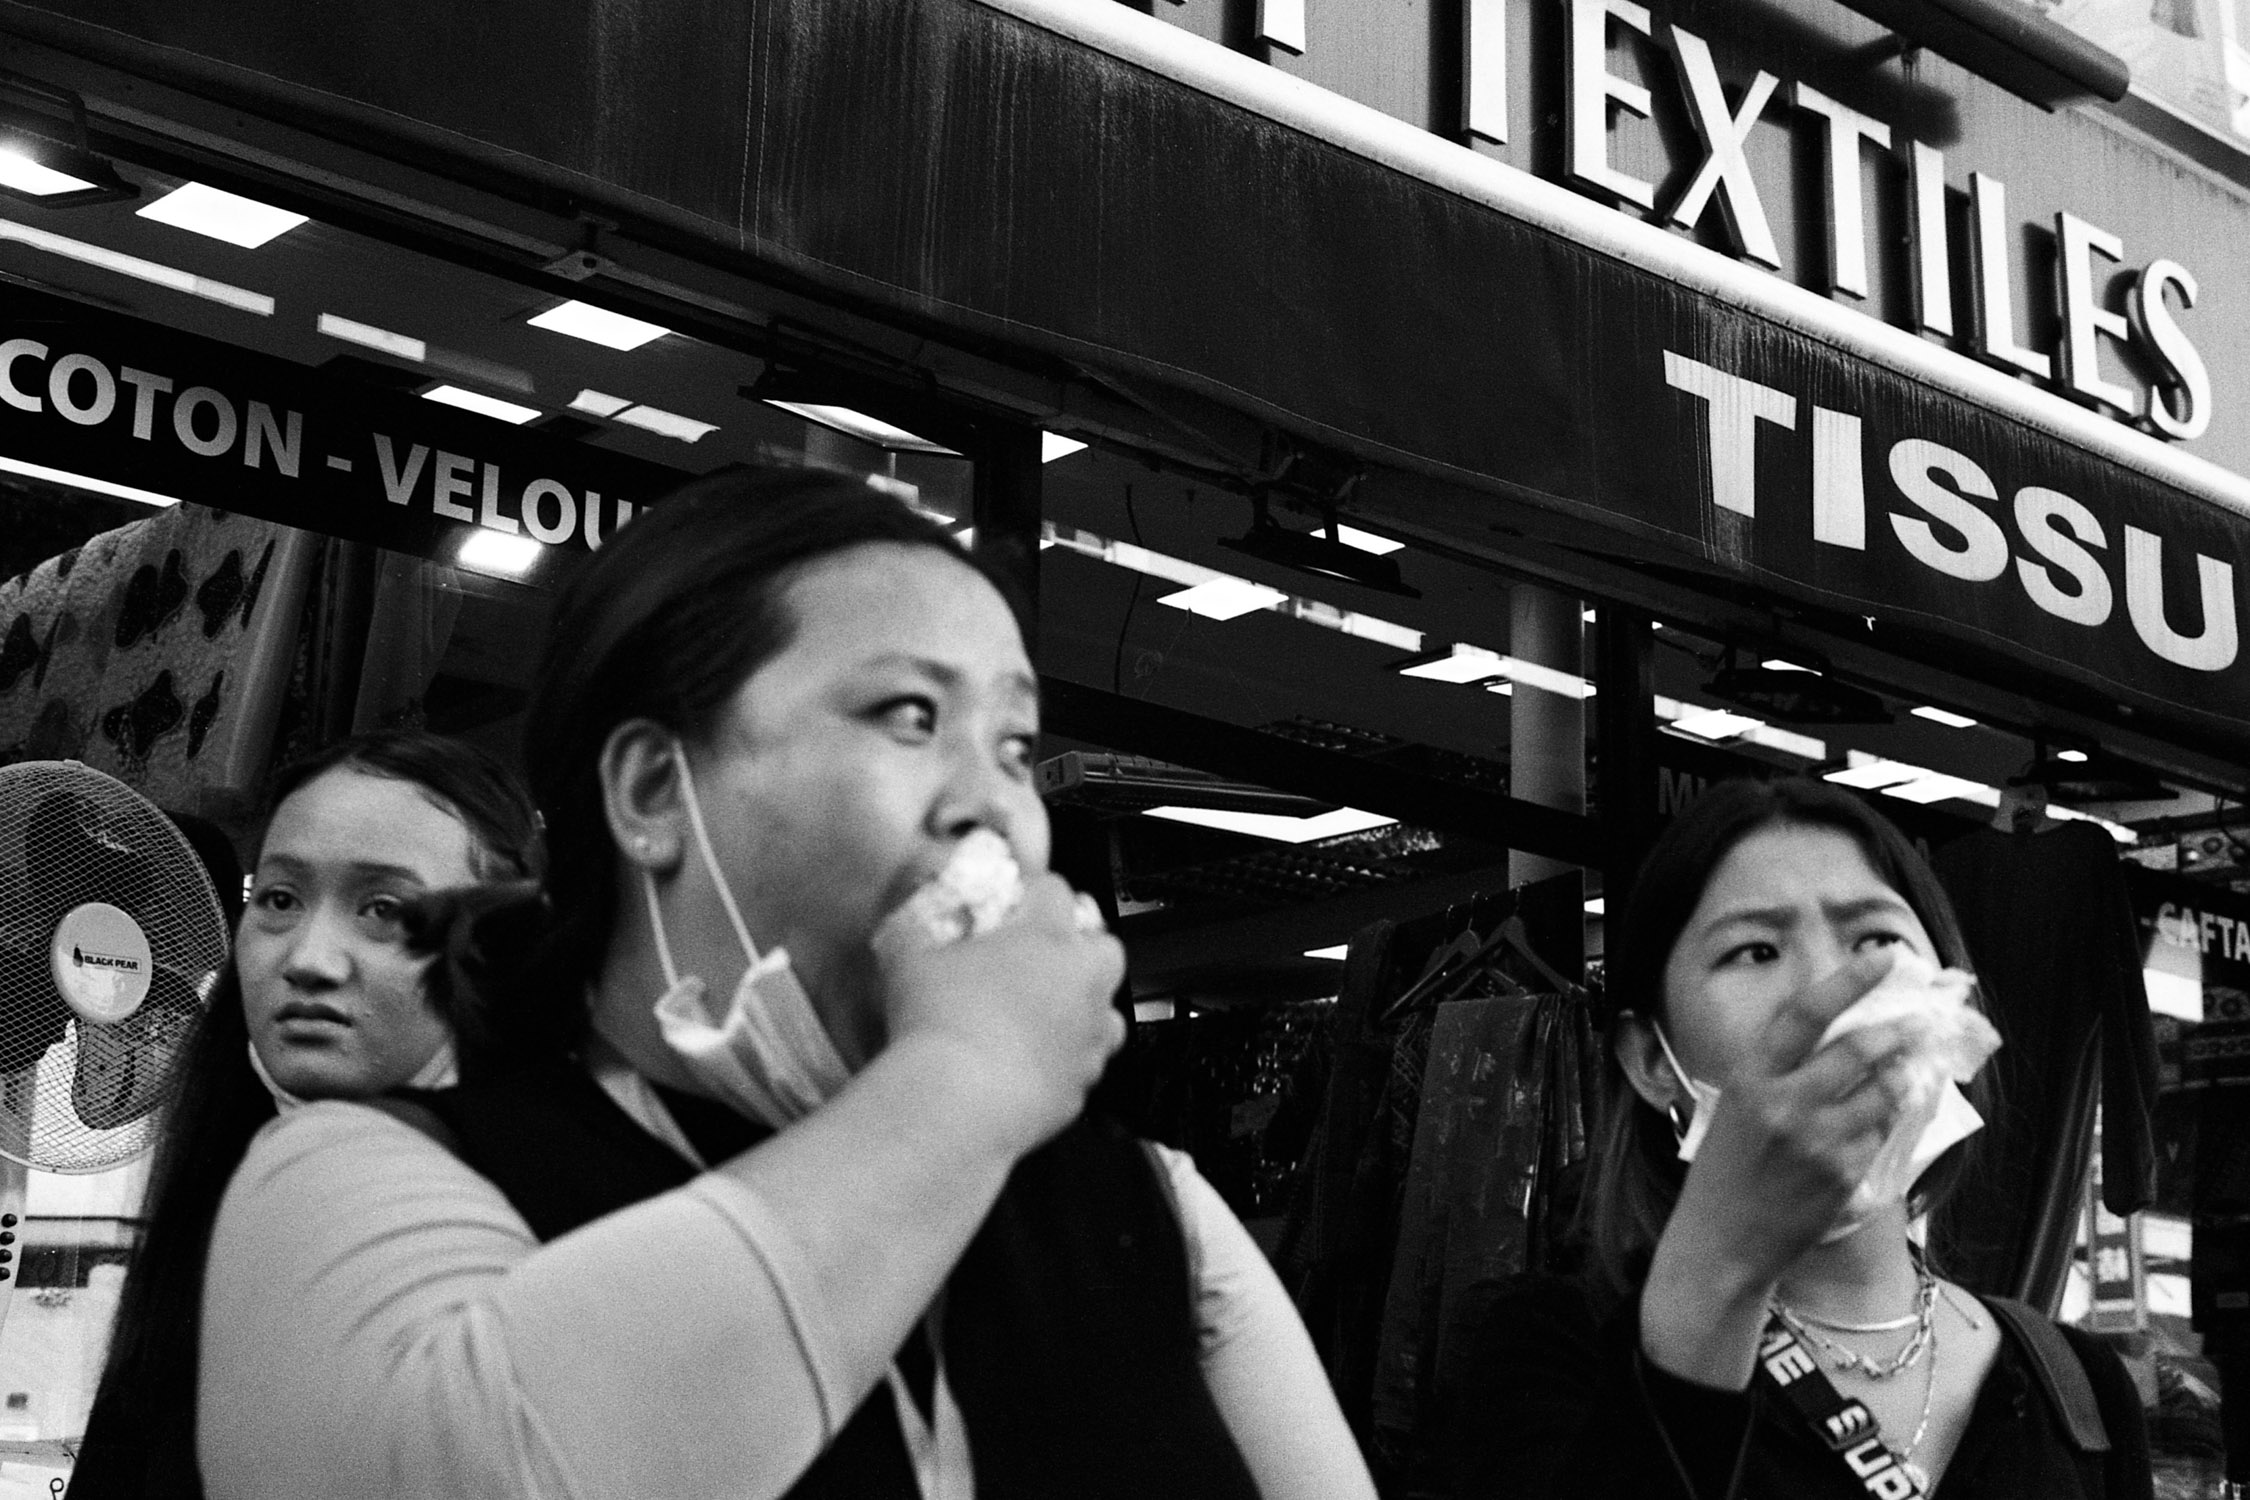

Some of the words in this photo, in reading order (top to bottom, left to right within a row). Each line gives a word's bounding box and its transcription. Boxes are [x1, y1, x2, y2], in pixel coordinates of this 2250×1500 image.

[0, 338, 303, 478] COTON
[373, 431, 652, 552] VELOU
[1663, 349, 2239, 673] TISSU
[84, 955, 114, 967] BLACK
[115, 959, 138, 971] PEAR
[1825, 1404, 1925, 1500] SUP
